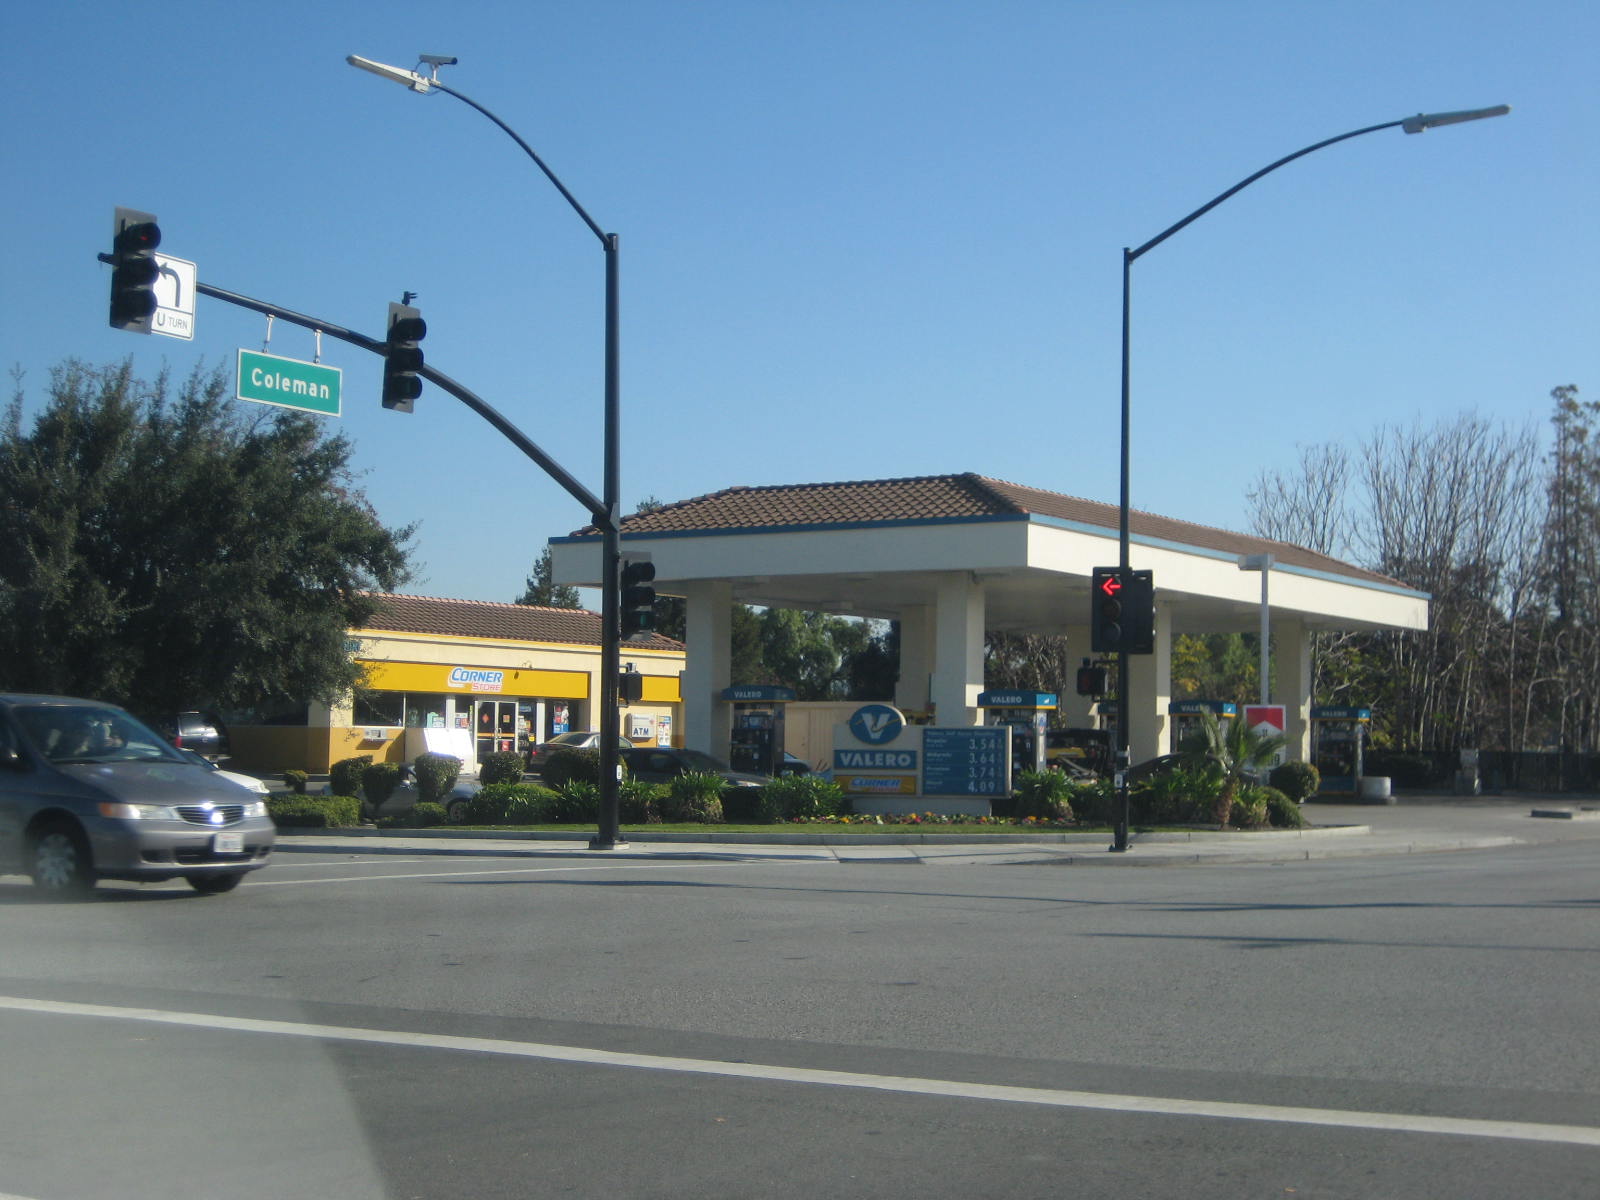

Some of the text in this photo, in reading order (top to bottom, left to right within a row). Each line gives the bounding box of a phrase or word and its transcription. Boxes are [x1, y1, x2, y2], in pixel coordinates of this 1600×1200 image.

[157, 311, 188, 330] U TURN
[251, 367, 329, 399] Coleman
[451, 667, 503, 683] CORNER
[991, 696, 1023, 704] VALERO
[633, 728, 649, 736] ATM
[840, 752, 911, 767] VALERO
